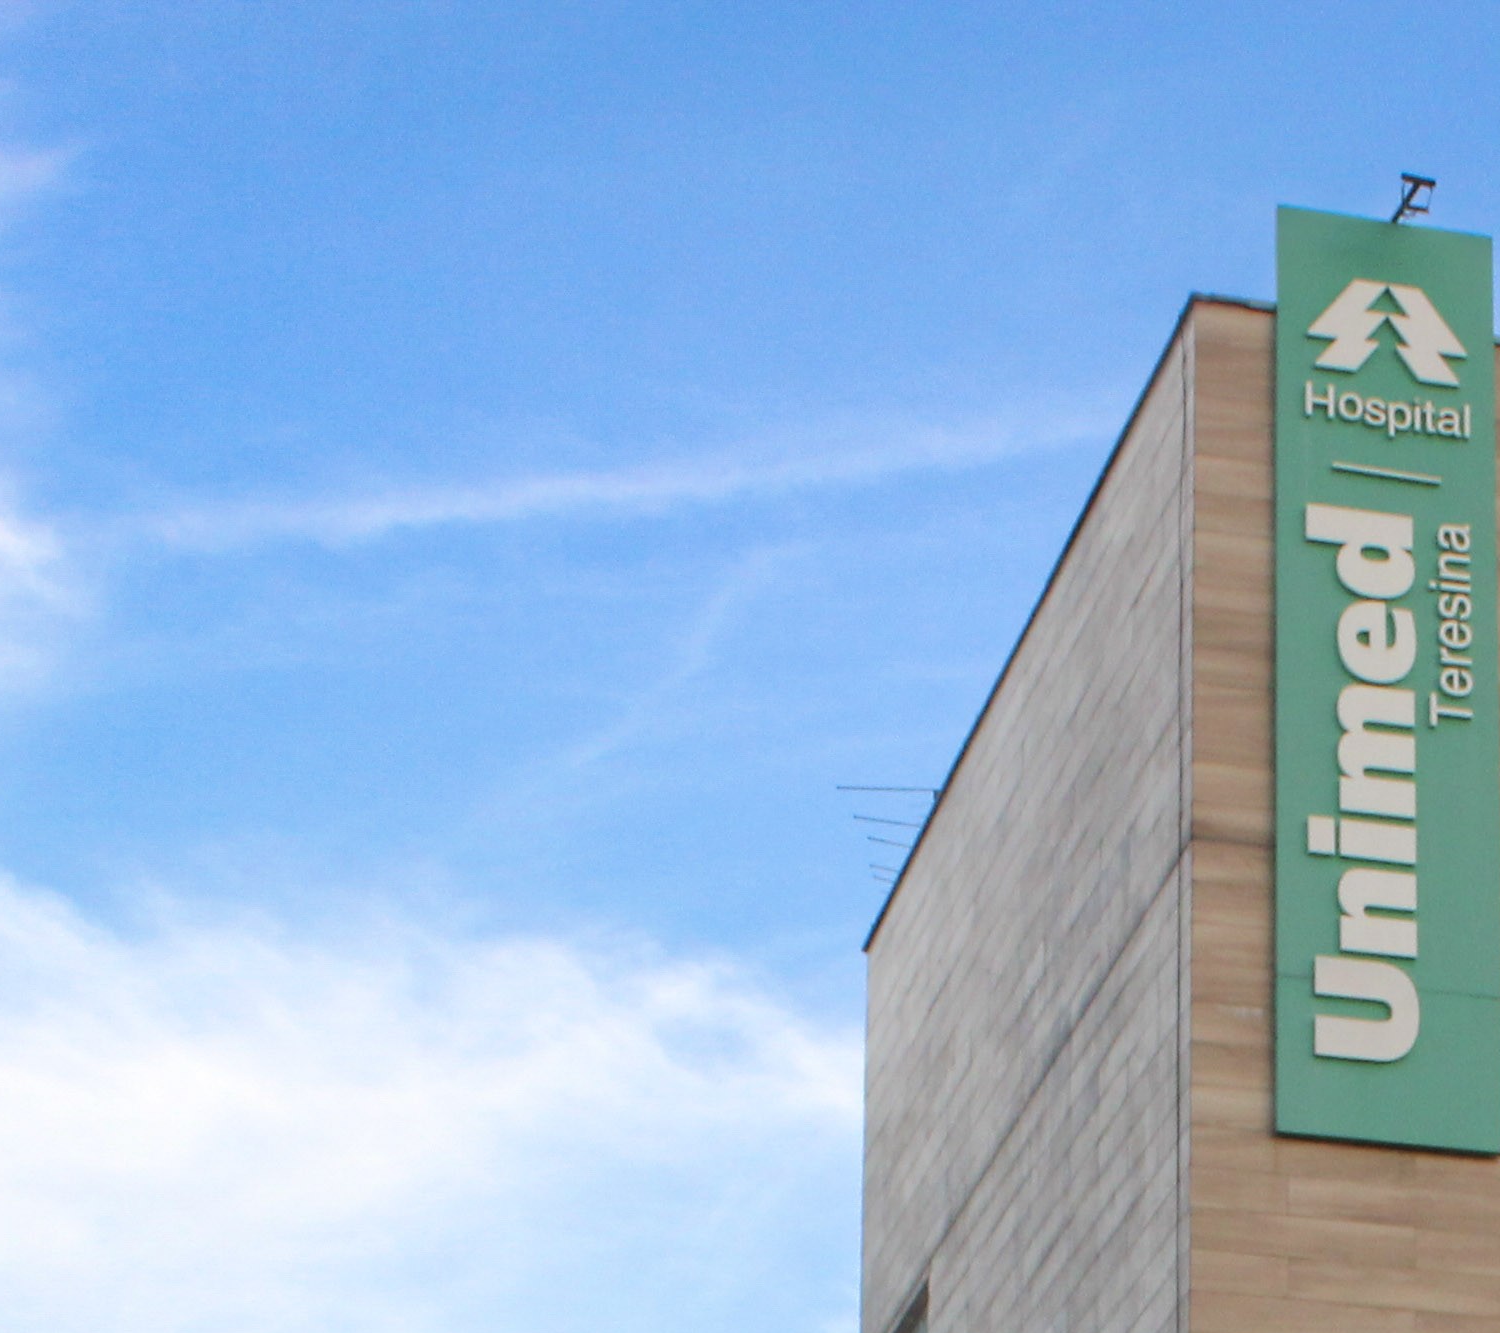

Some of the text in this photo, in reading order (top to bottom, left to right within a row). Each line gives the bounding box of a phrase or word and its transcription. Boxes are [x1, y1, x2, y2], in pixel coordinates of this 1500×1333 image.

[1303, 380, 1471, 439] Hospital
[1428, 523, 1474, 728] Teresina
[1305, 502, 1420, 1064] Unimed
